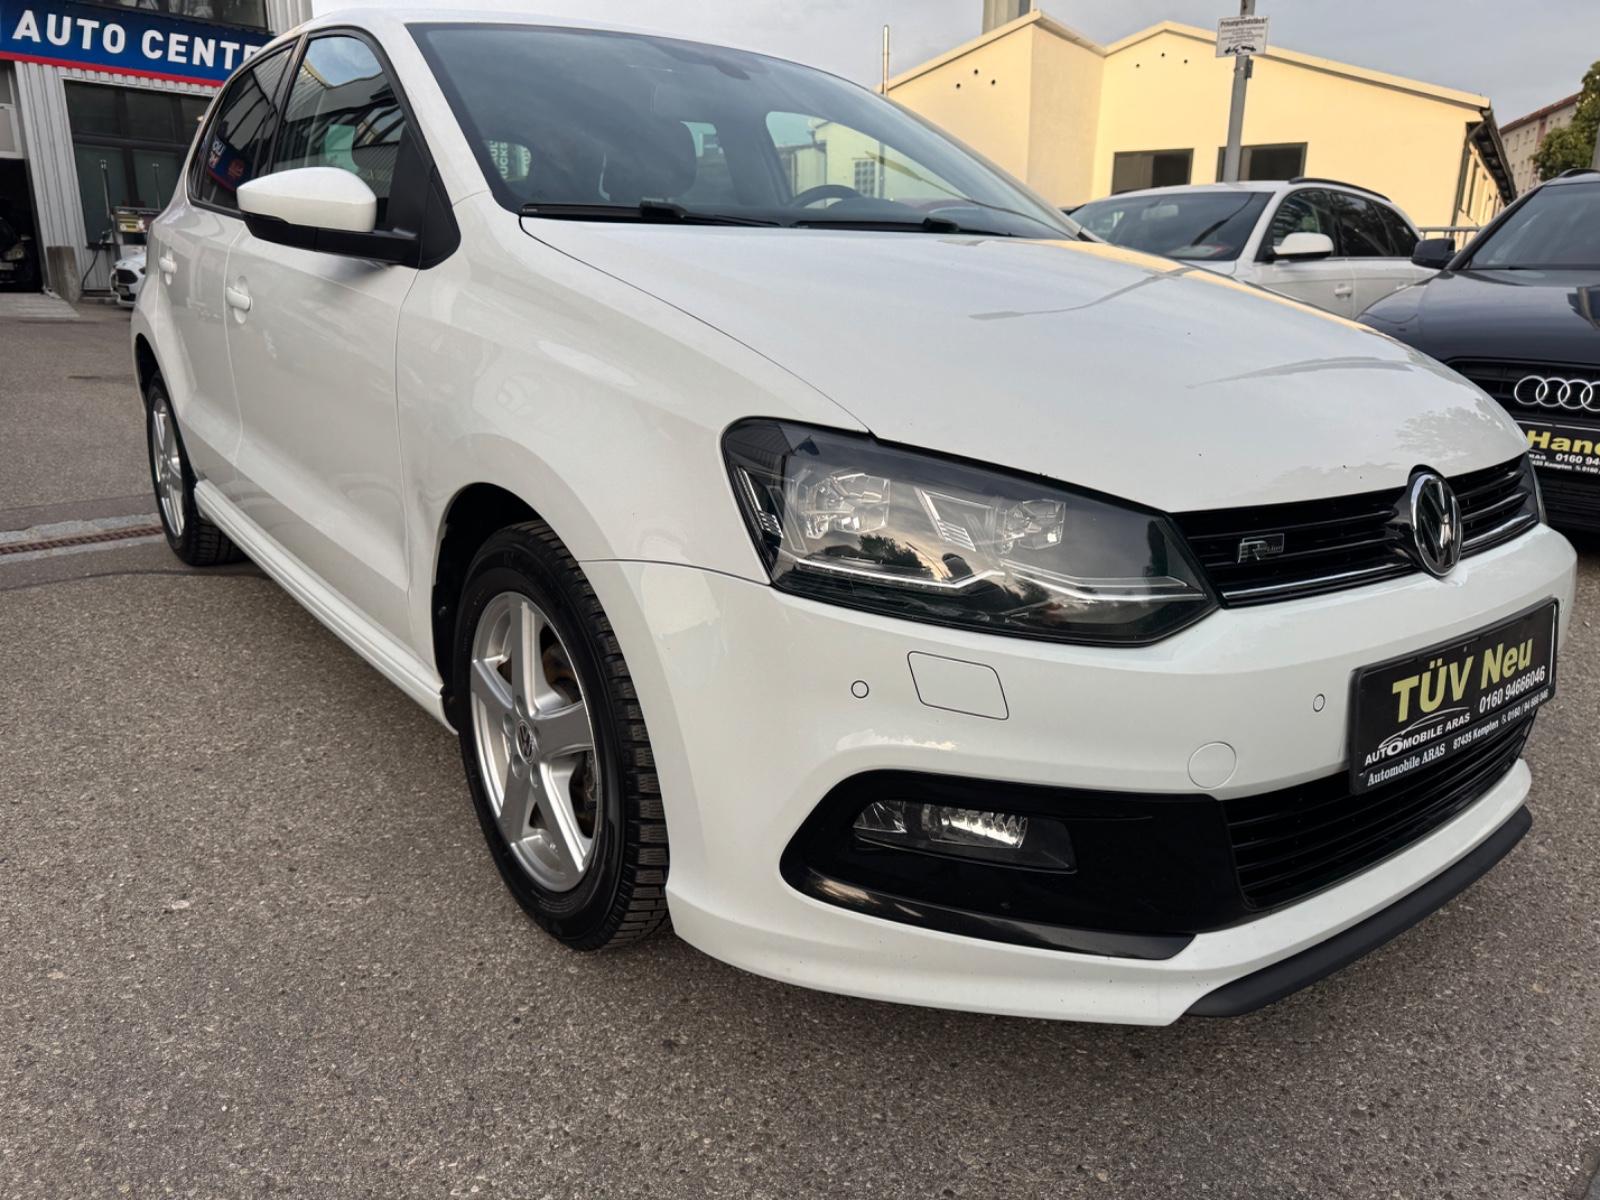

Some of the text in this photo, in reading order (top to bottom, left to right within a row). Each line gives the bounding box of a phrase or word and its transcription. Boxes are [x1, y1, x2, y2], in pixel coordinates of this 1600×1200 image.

[11, 9, 127, 54] AUTO
[1555, 453, 1583, 464] 0160
[1585, 456, 1600, 466] 94
[1392, 638, 1533, 723] TÜV Neu
[1479, 665, 1546, 714] 0160 94666046
[1364, 712, 1471, 767] AUTOMOBILE ARAS
[1367, 756, 1421, 787] Automobile
[1421, 743, 1446, 764] ARAS
[1453, 731, 1472, 749] 87435
[1473, 720, 1499, 740] Kempten
